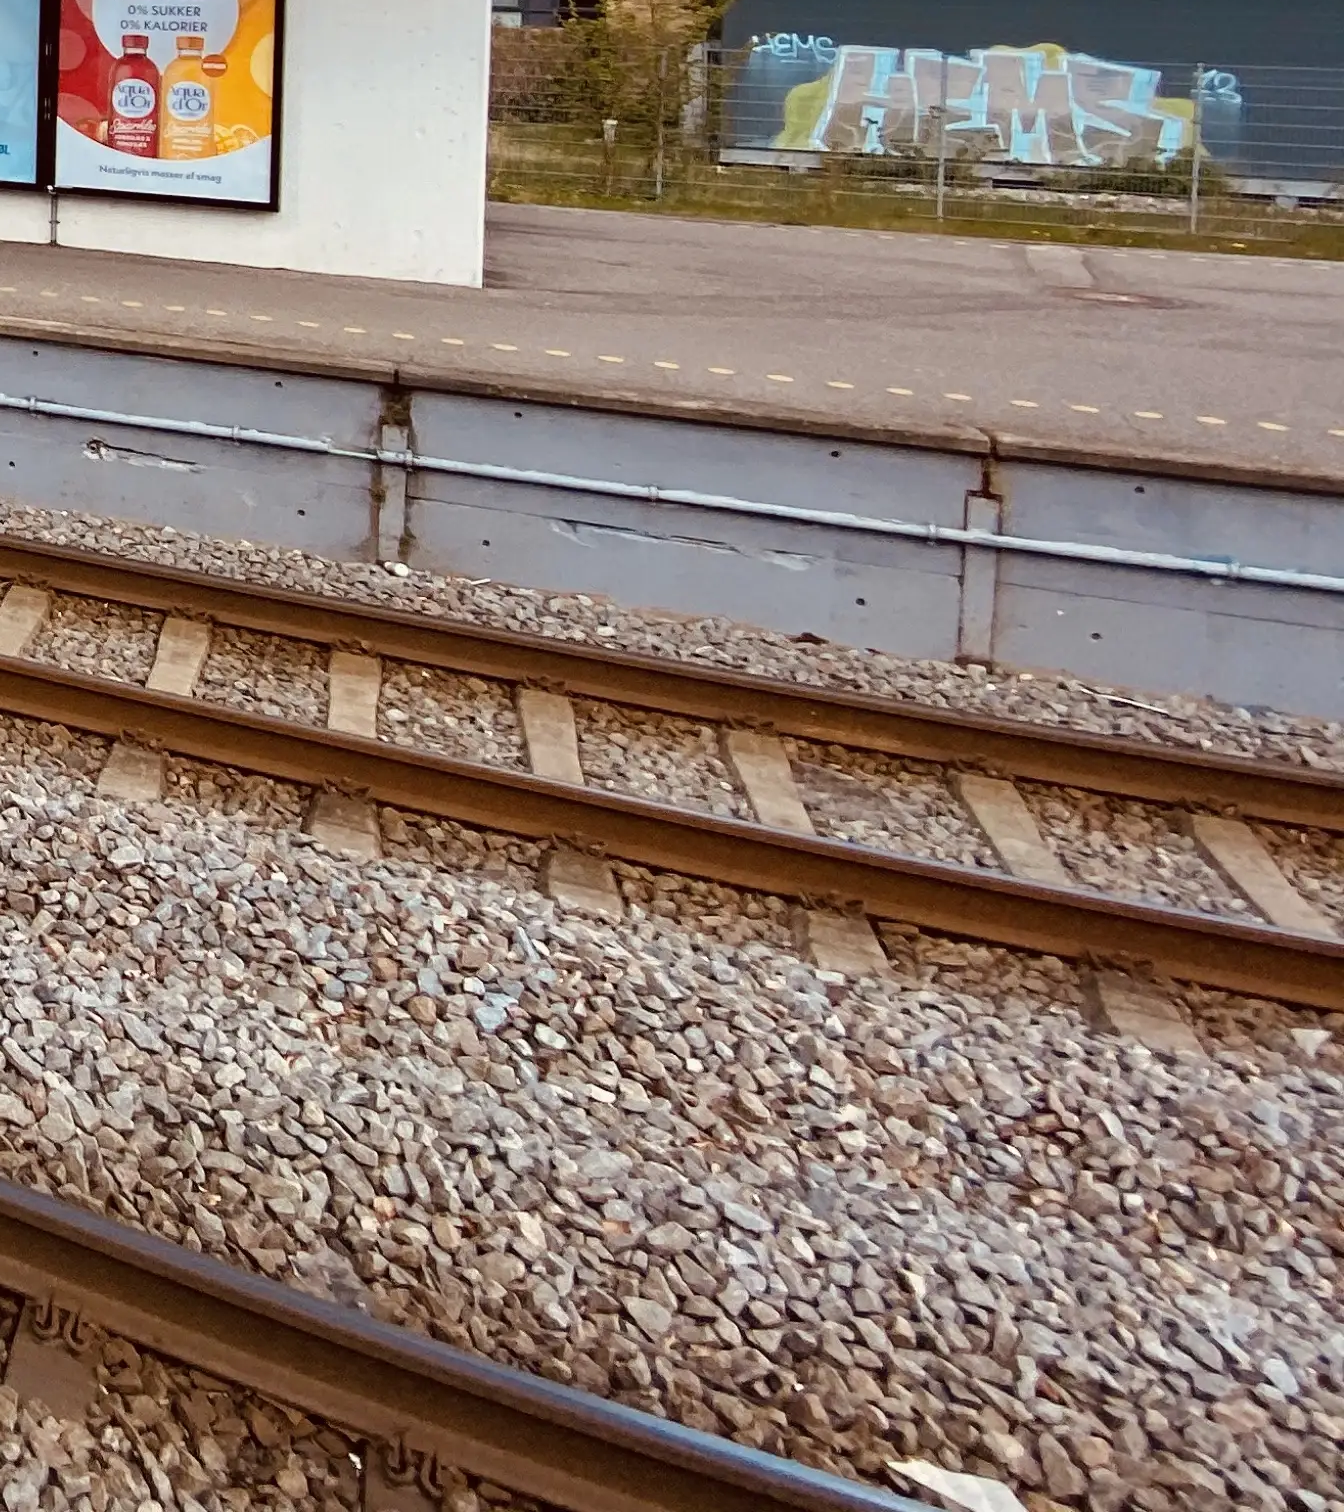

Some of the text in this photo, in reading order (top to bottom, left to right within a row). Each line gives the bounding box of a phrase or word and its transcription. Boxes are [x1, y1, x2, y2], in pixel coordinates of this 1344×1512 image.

[127, 5, 202, 17] 0% SUKKER
[120, 19, 208, 32] 0% KALORIER
